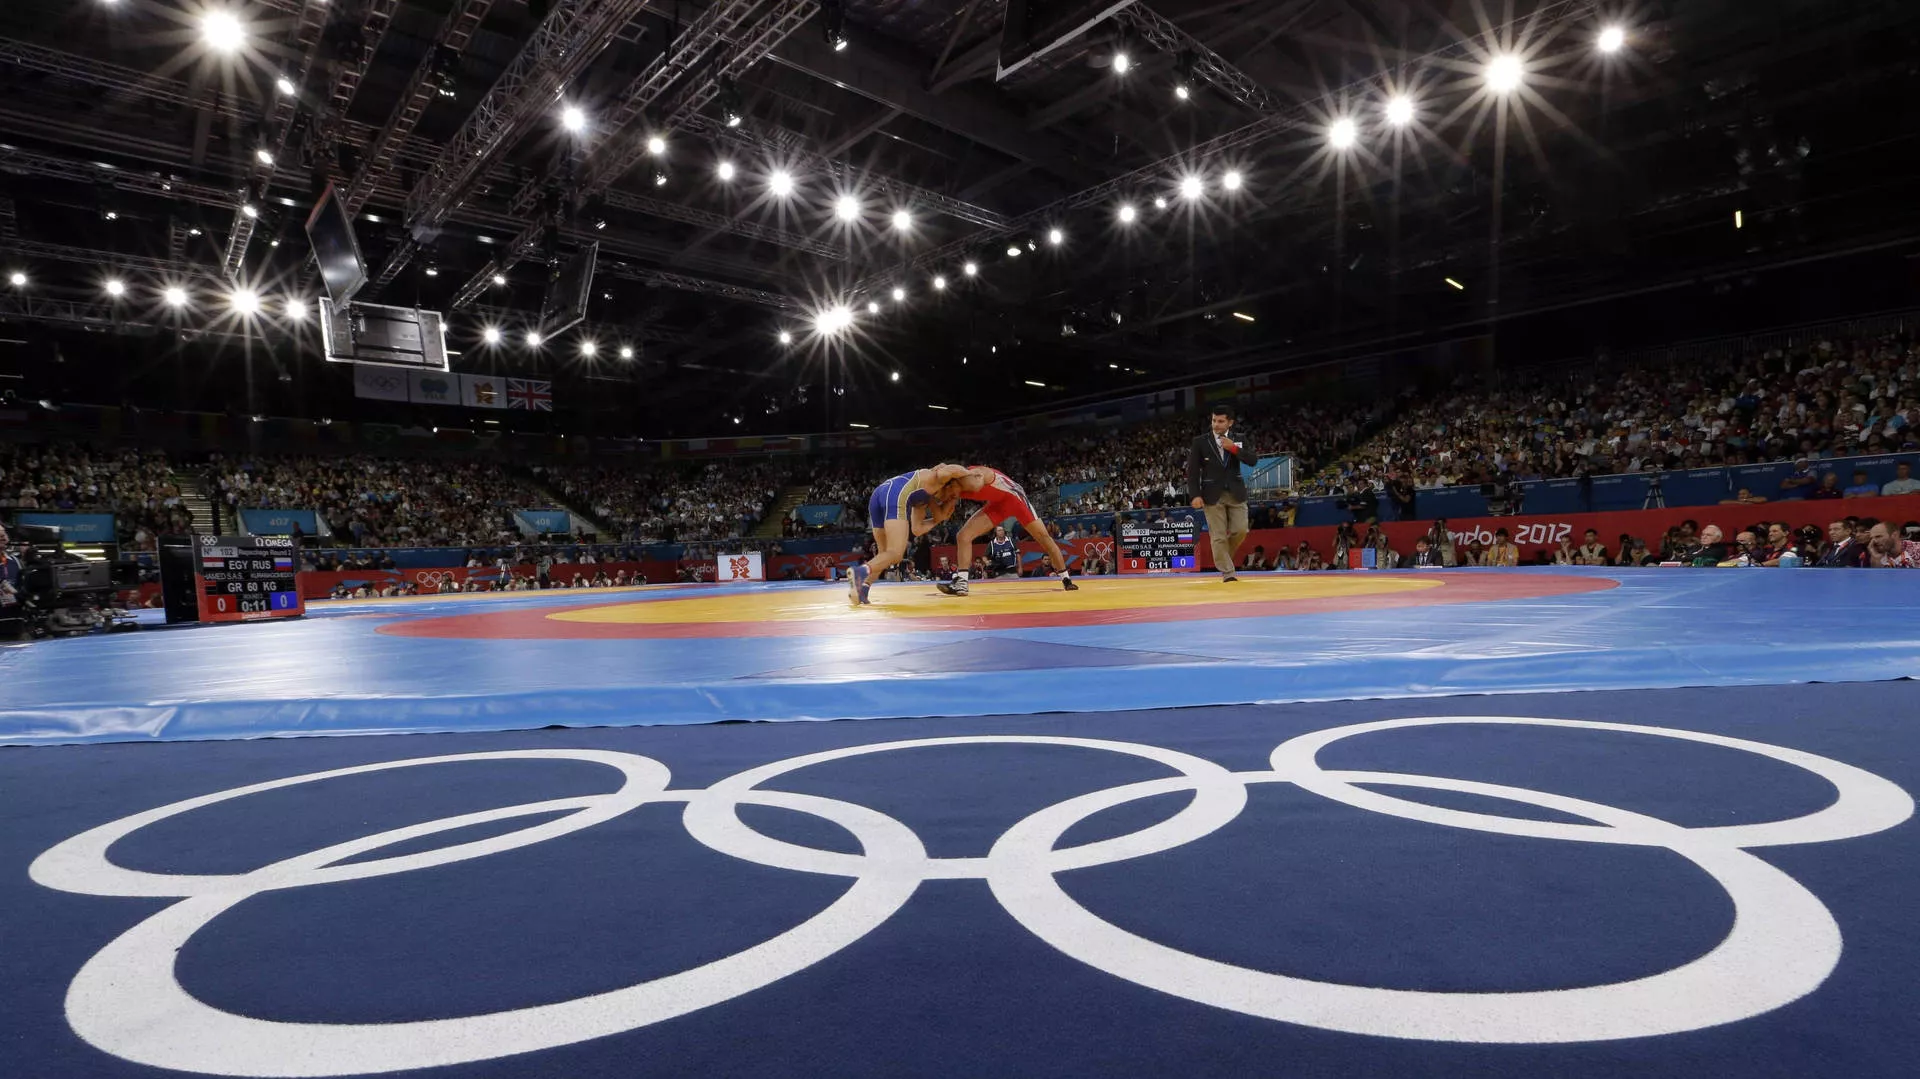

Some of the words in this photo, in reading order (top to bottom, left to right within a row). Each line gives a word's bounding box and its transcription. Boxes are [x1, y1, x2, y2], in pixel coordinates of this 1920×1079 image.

[1514, 522, 1572, 545] 2012
[265, 538, 293, 547] OMEGA
[228, 561, 248, 570] EGY
[252, 560, 271, 570] RUS
[1131, 560, 1138, 569] 0
[1149, 561, 1168, 569] 0:11
[1180, 558, 1186, 567] 0
[227, 582, 243, 592] GR
[247, 582, 258, 591] 60
[263, 581, 277, 591] KG
[217, 597, 226, 612] 0
[241, 599, 266, 612] 0:11
[280, 594, 288, 608] 0
